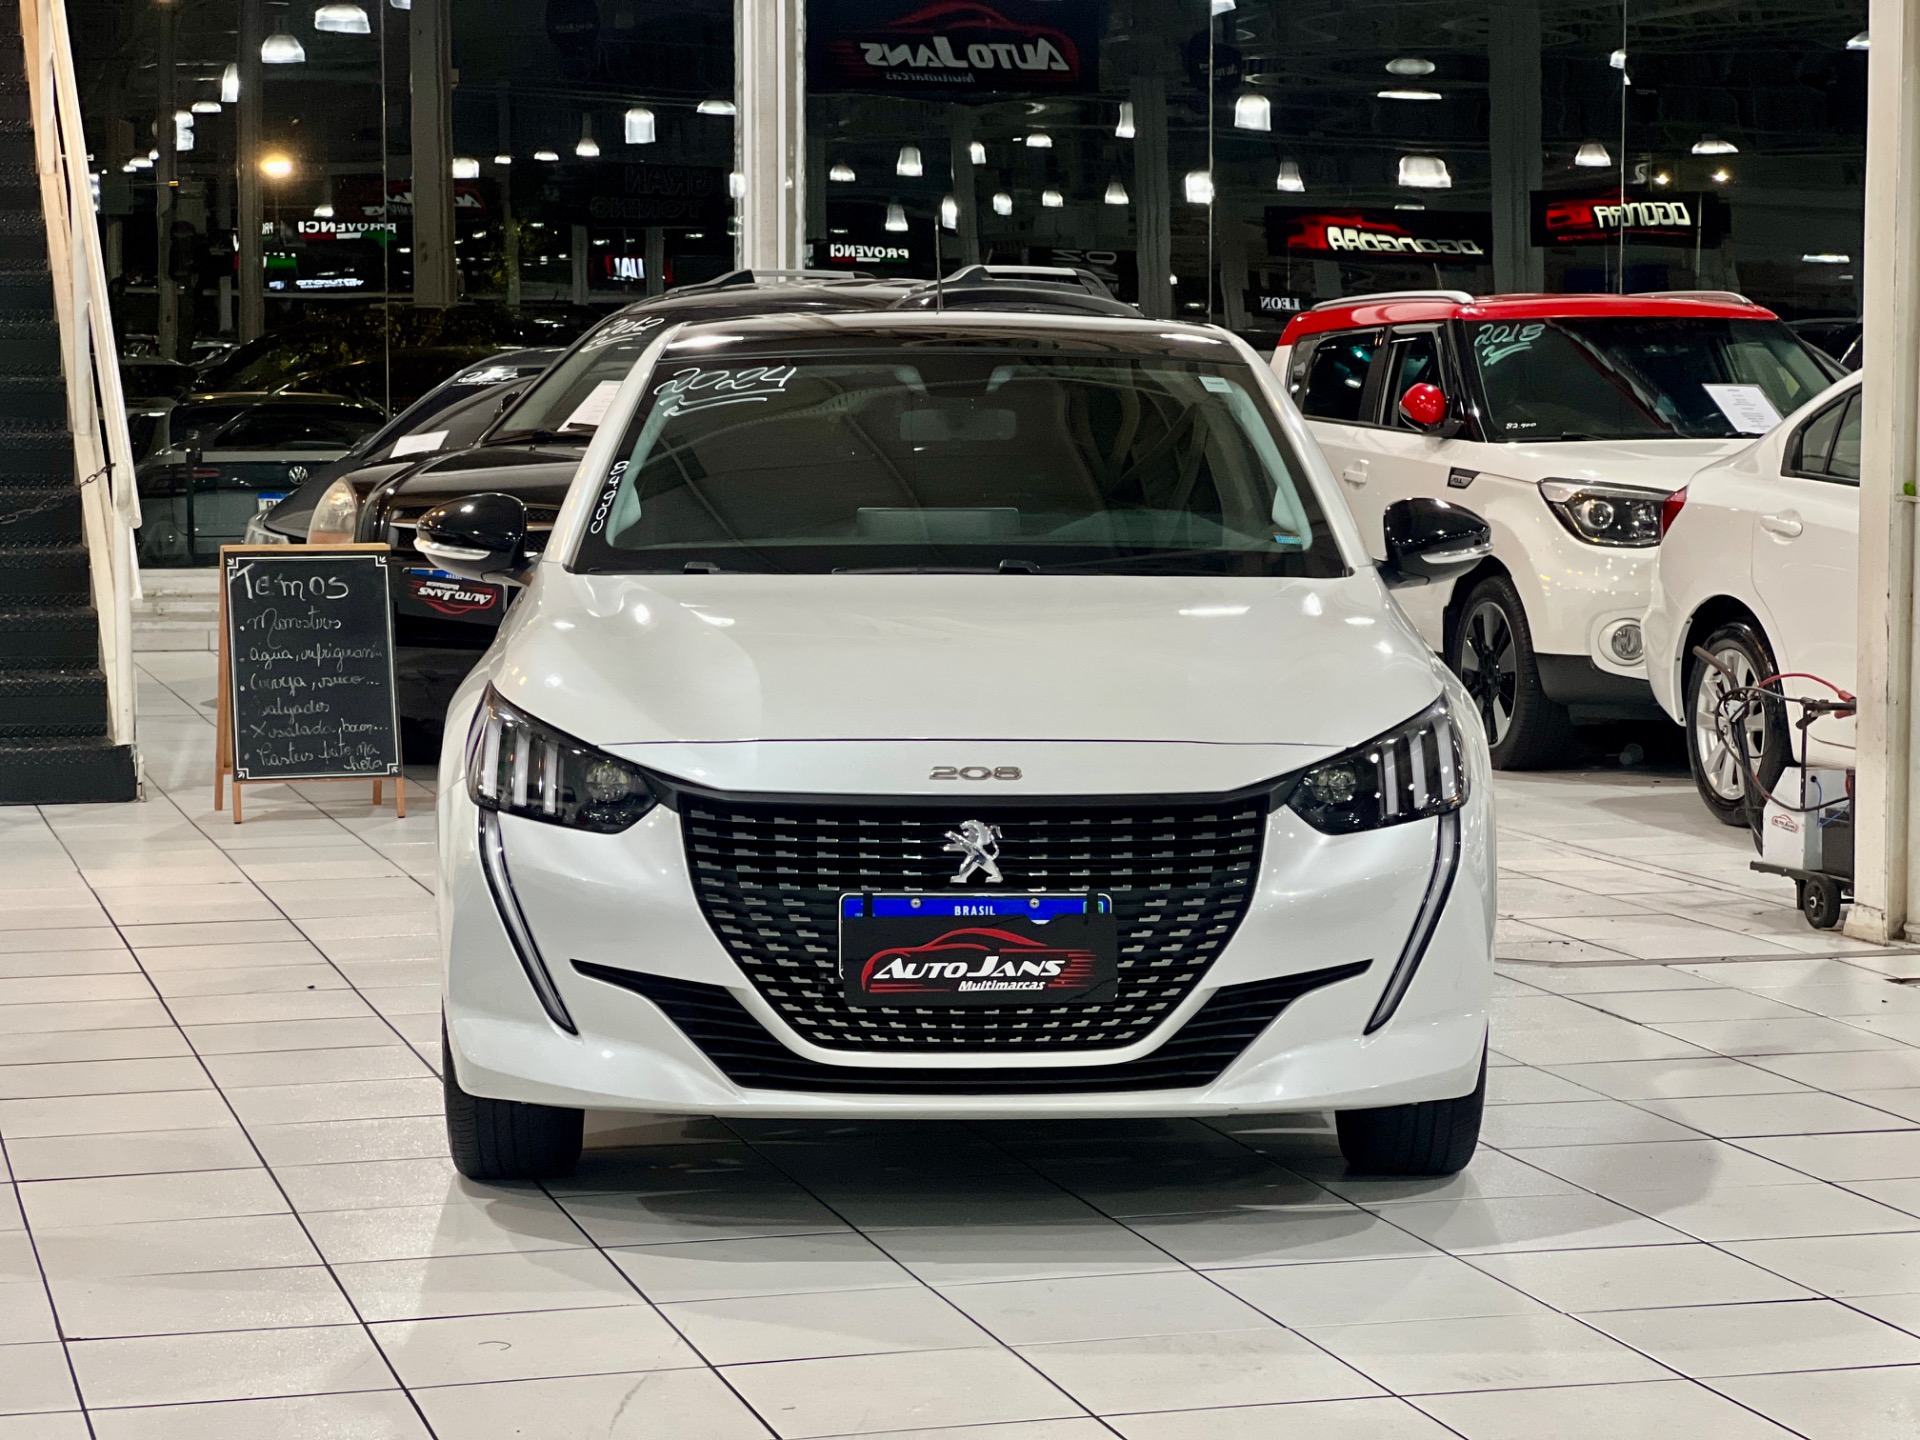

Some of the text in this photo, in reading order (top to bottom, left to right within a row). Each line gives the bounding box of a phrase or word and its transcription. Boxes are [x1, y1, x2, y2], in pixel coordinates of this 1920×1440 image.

[1474, 323, 1546, 347] 2018
[652, 364, 798, 397] 2024
[928, 765, 1024, 781] 208
[953, 904, 997, 917] BRASIL
[957, 979, 1047, 992] Multimarcas
